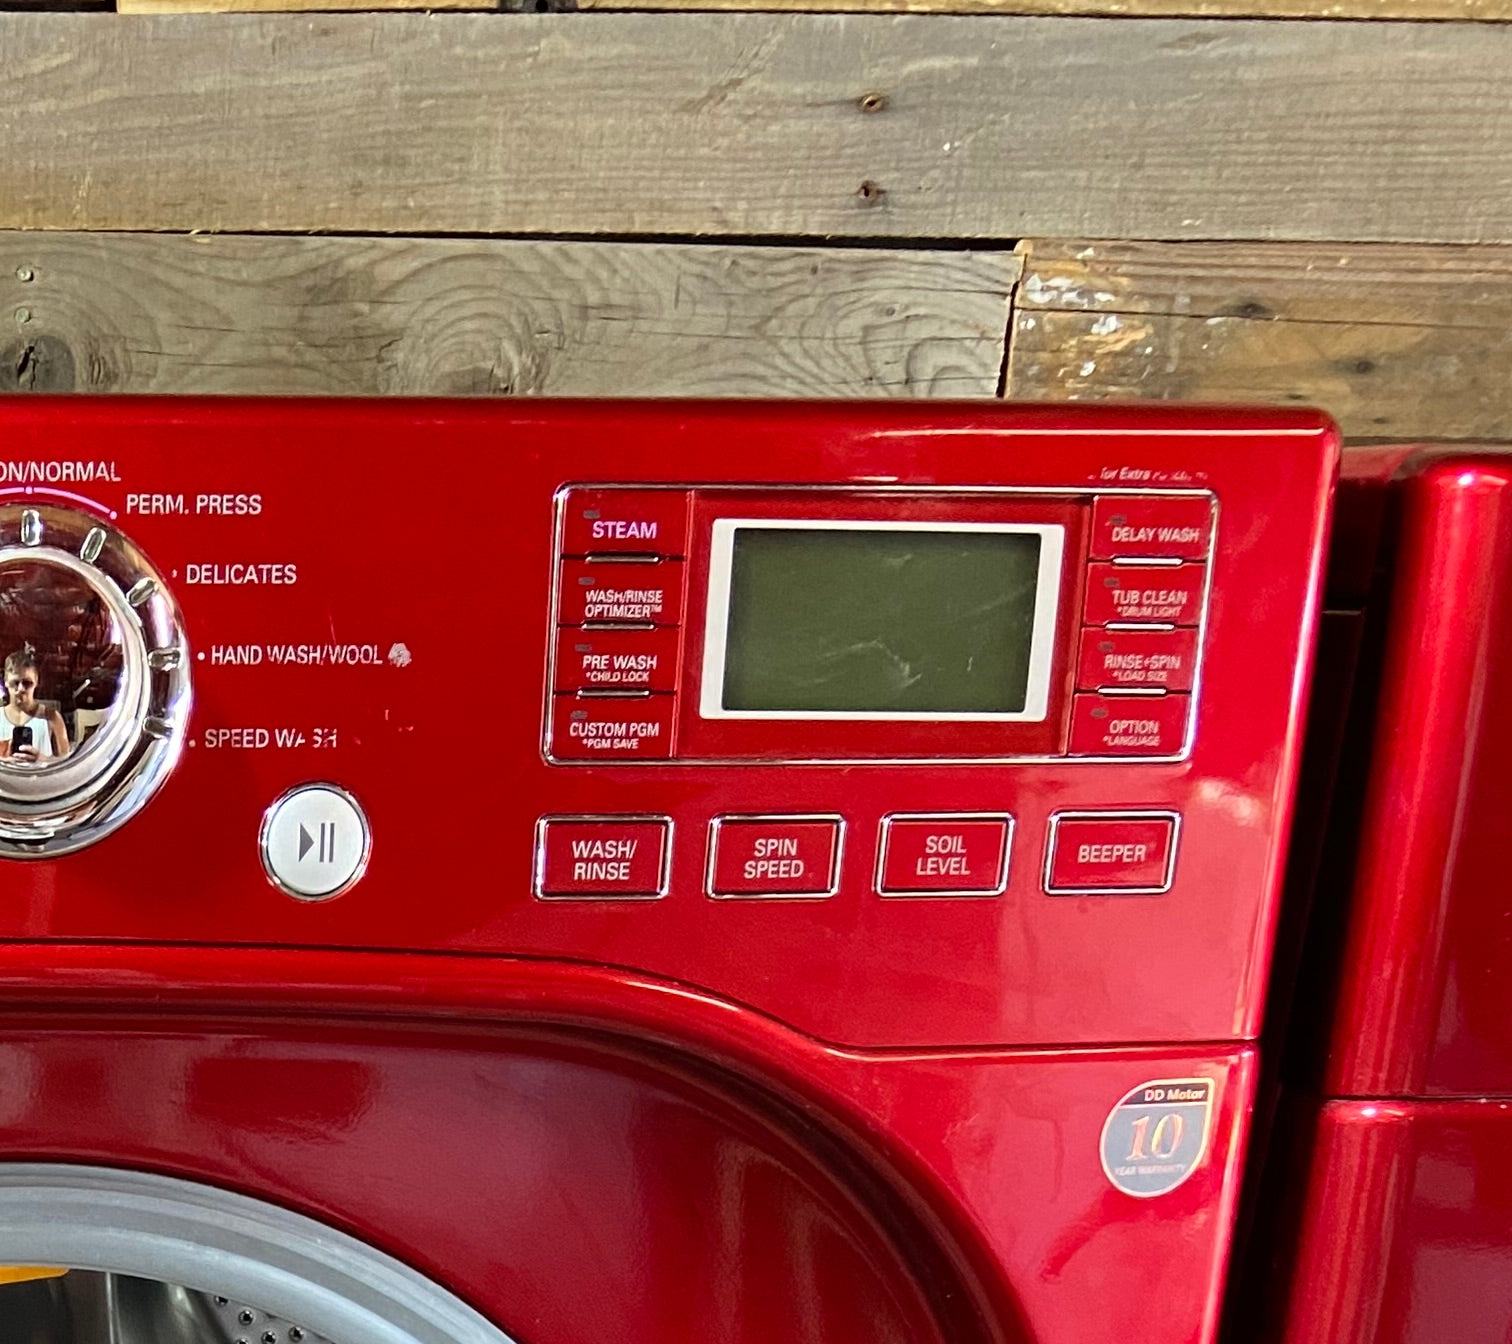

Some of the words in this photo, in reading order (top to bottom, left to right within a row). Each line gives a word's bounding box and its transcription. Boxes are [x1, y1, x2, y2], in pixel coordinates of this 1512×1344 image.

[126, 494, 189, 515] PERM.
[196, 494, 262, 515] PRESS
[592, 521, 657, 539] STEAM
[1112, 527, 1155, 543] DELAY
[1157, 527, 1200, 543] WASH
[186, 563, 297, 585] DELICATES
[585, 589, 663, 604] WASH/RINSE
[1112, 589, 1139, 604] TUB
[1142, 590, 1188, 605] CLEAN
[1154, 606, 1182, 617] LIGHT
[211, 644, 262, 665] HAND
[267, 644, 383, 666] WASH/WOOL
[582, 655, 610, 669] PRE
[613, 655, 657, 670] WASH
[1104, 654, 1181, 670] RINSE+SPIN
[622, 671, 649, 682] LOCK
[1147, 671, 1168, 682] SIZE
[569, 721, 627, 738] CUSTOM
[629, 721, 660, 738] PGM
[1109, 719, 1159, 734] OPTION
[204, 729, 269, 749] SPEED
[613, 738, 639, 749] SAVE
[571, 839, 637, 860] WASH/
[753, 838, 797, 858] SPIN
[925, 835, 968, 855] SOIL
[1077, 843, 1146, 864] BEEPER
[574, 860, 630, 882] RINSE
[743, 859, 805, 879] SPEED
[916, 856, 971, 876] LEVEL
[1144, 1089, 1164, 1101] DD
[1167, 1088, 1206, 1101] Motor
[1125, 1114, 1183, 1161] 10
